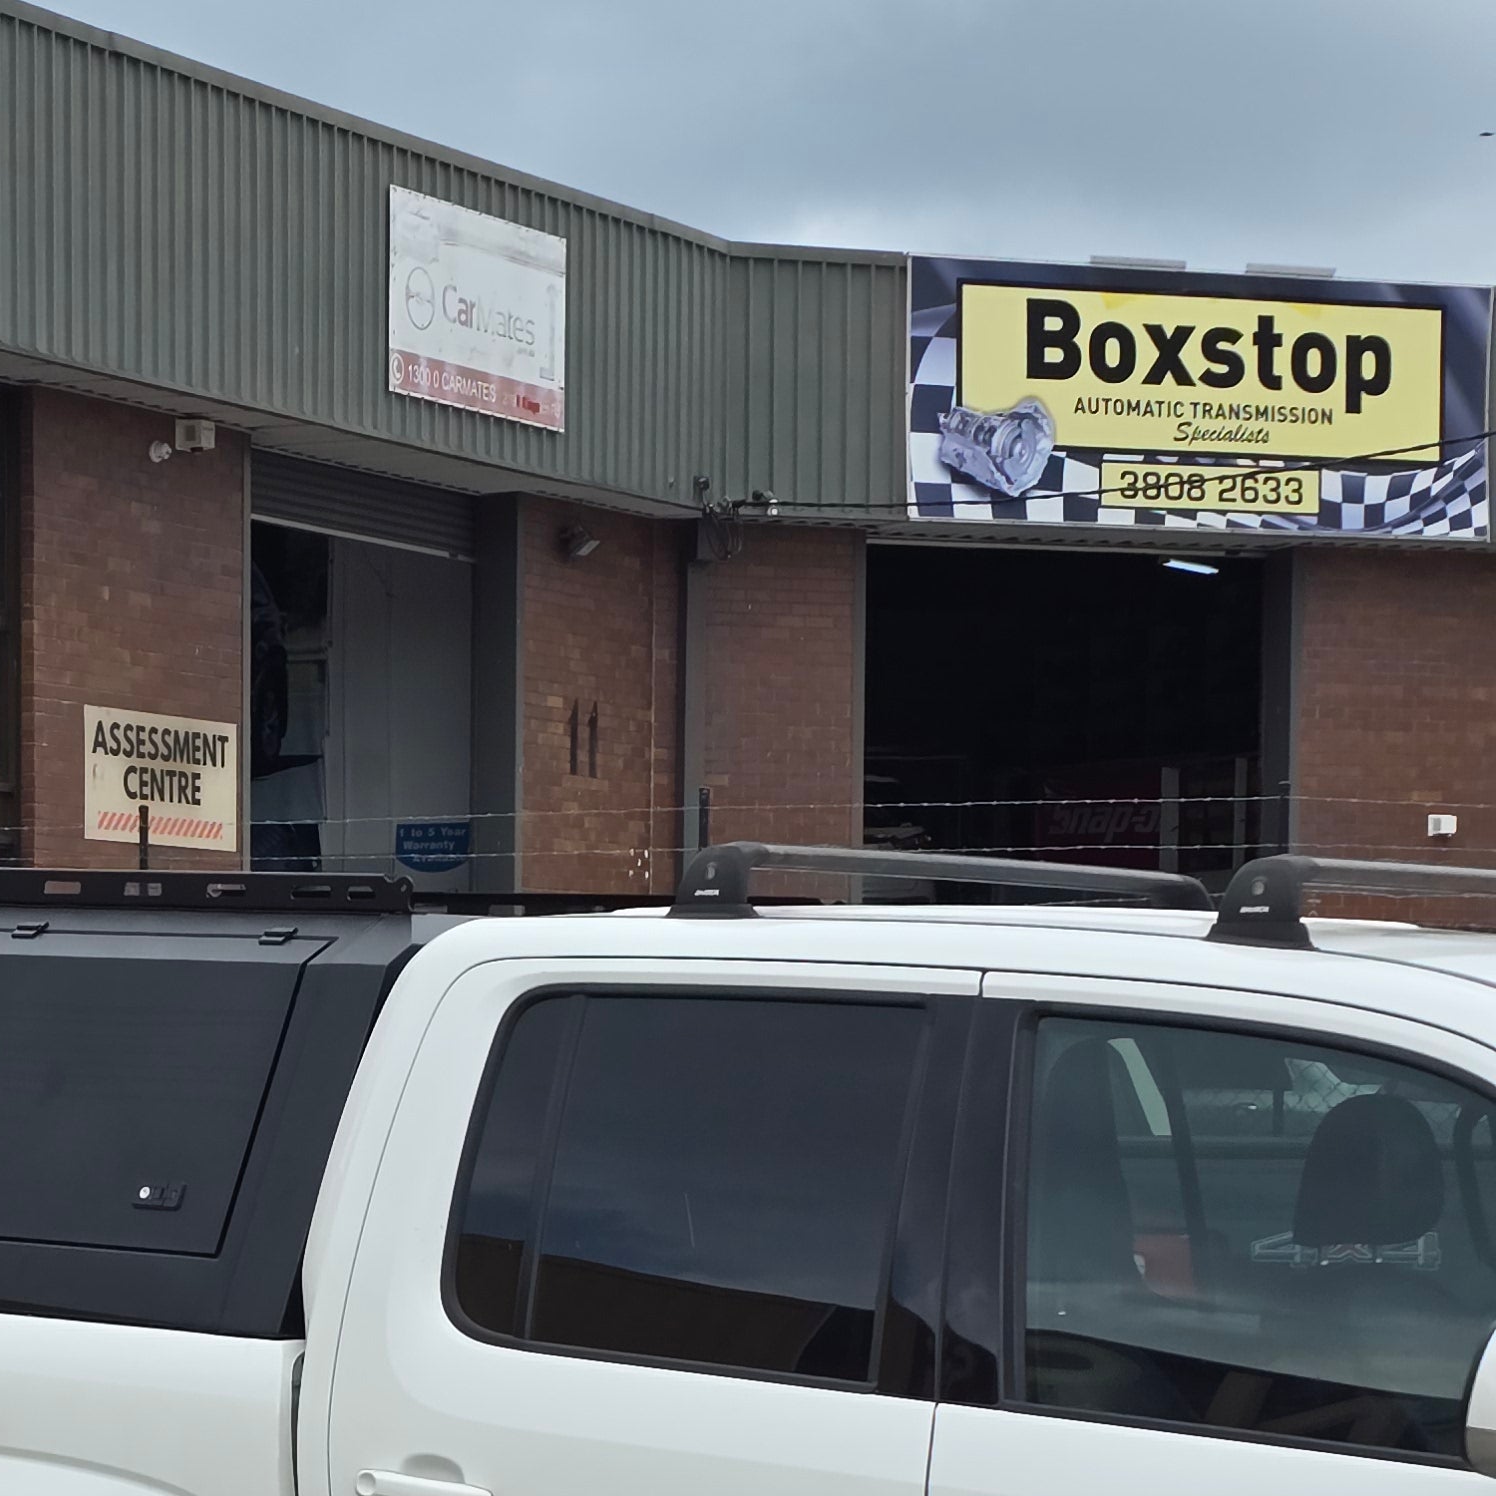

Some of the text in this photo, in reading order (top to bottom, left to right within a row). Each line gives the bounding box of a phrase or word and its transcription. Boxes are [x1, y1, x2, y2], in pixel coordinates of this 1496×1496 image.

[442, 284, 535, 345] CarMates
[1026, 297, 1391, 414] Boxstop
[408, 363, 496, 403] 1300 0 CARMATES
[1074, 397, 1333, 425] AUTOMATIC TRANSMISSION
[1173, 421, 1270, 446] Specialists
[1120, 470, 1303, 506] 3808 2633
[92, 719, 229, 768] ASSESSMENT
[568, 697, 599, 778] 11
[123, 765, 201, 806] CENTRE
[402, 840, 455, 851] Warranty
